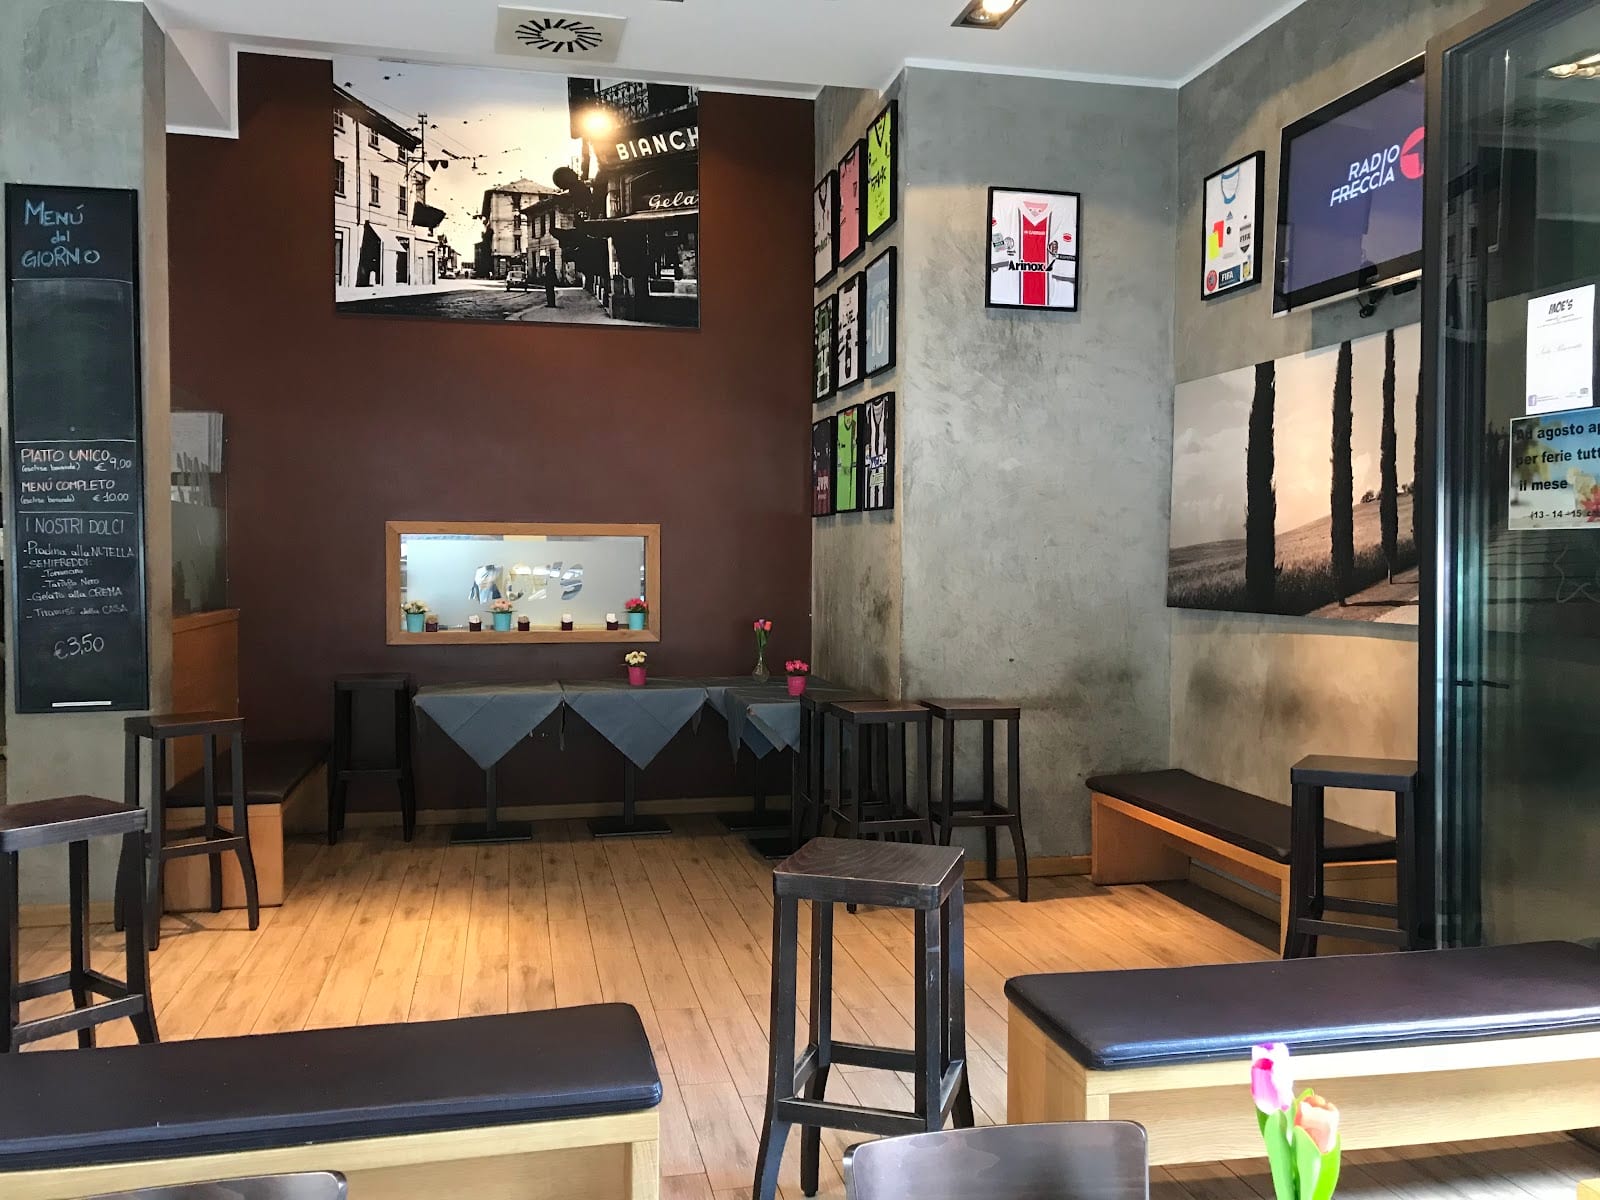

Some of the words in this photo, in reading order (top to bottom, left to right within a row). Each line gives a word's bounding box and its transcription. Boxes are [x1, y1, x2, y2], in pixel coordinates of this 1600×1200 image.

[616, 126, 698, 161] BIANCH
[1347, 145, 1400, 183] RADIO
[1329, 166, 1395, 207] FRECCIA
[21, 246, 101, 268] GIORNO
[1008, 259, 1046, 272] Arinox
[1221, 271, 1234, 281] FIFA
[1548, 299, 1574, 315] MOE'S
[1537, 424, 1584, 441] agosto
[21, 448, 65, 463] PIATTO
[69, 448, 110, 462] UNICO
[1542, 450, 1572, 464] ferie
[55, 479, 115, 492] COMPLETO
[1520, 480, 1527, 492] il
[1531, 479, 1568, 491] mese
[1552, 510, 1563, 518] 14
[25, 517, 29, 532] I
[35, 517, 83, 535] NOSTRI
[88, 518, 124, 536] DOLCI
[70, 543, 90, 557] alla
[67, 590, 88, 599] alla
[88, 586, 123, 598] CREMA
[101, 604, 129, 615] CASA
